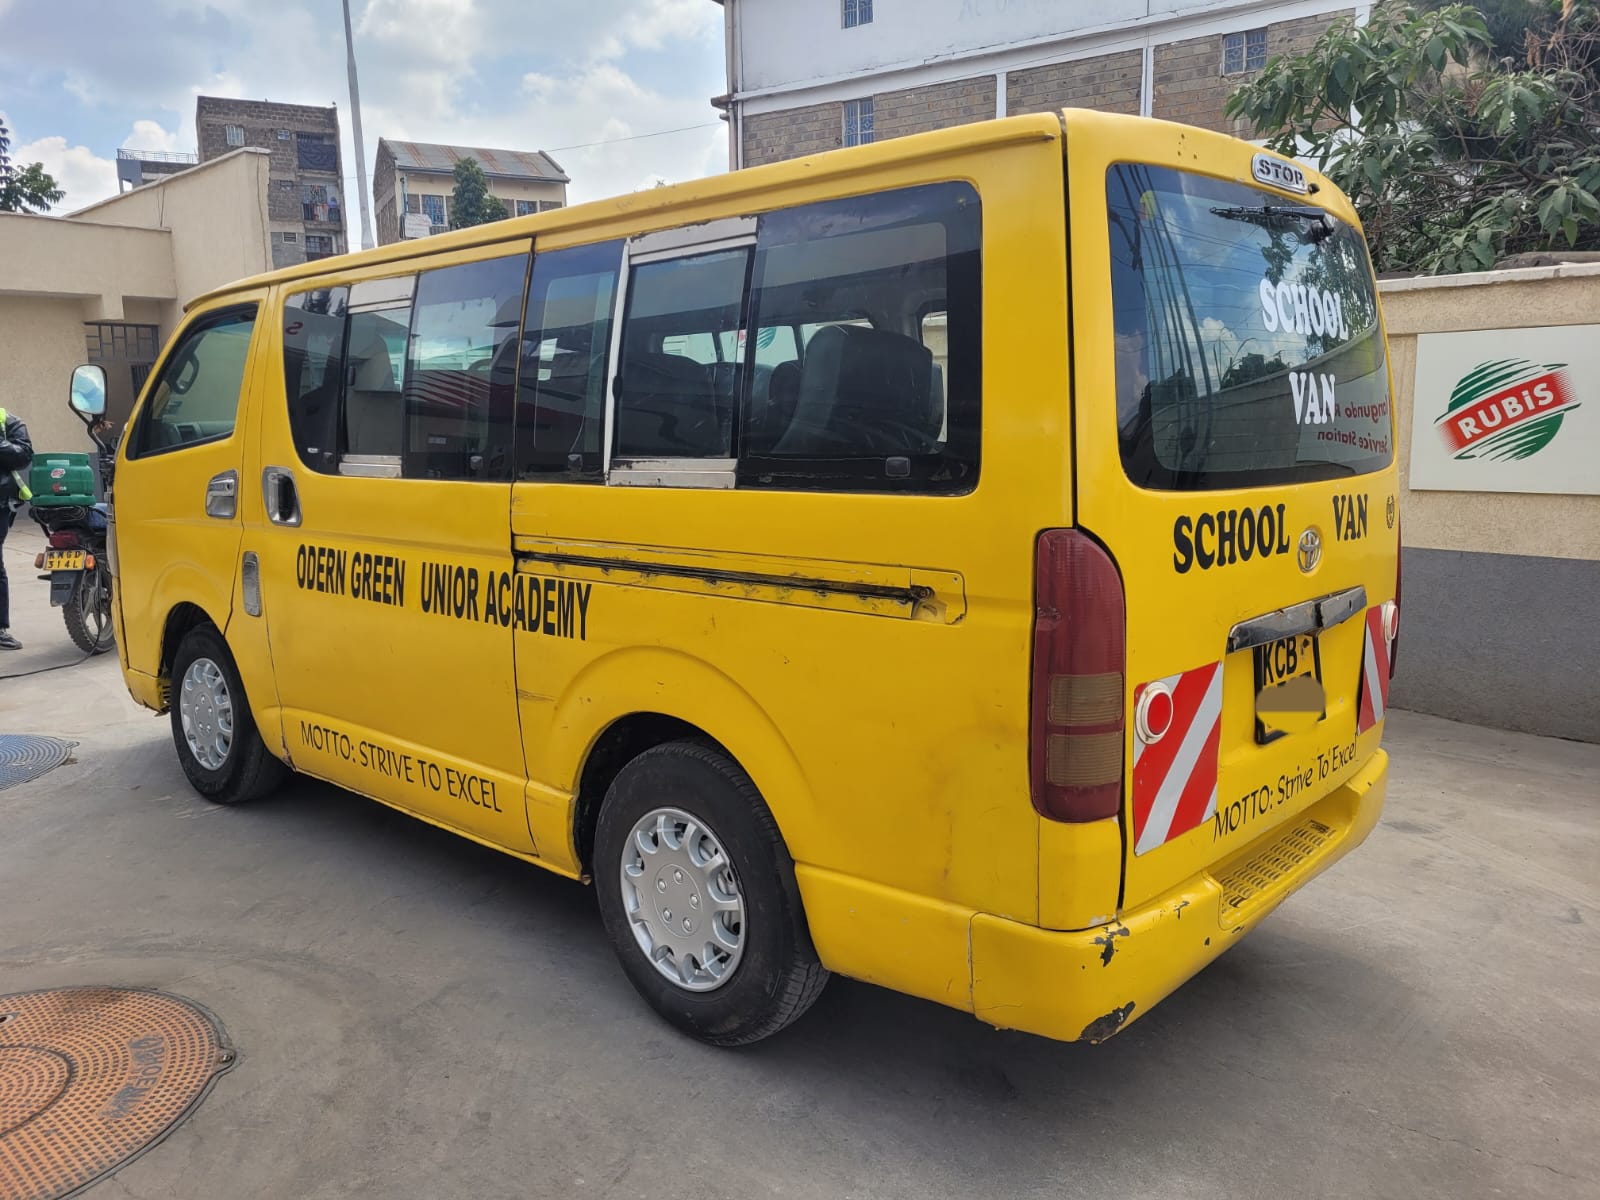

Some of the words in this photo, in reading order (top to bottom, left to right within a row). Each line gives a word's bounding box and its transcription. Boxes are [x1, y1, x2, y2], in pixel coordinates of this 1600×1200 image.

[1259, 159, 1303, 185] STOP
[1259, 278, 1349, 340] SCHOOL
[1288, 371, 1336, 425] VAN
[1173, 503, 1290, 574] SCHOOL
[1331, 493, 1369, 542] VAN
[296, 543, 347, 596] ODERN
[350, 551, 406, 608] GREEN
[420, 561, 479, 622] UNIOR
[484, 570, 593, 641] ACADEMY
[300, 721, 356, 764] MOTTO:
[359, 740, 414, 783] STRIVE
[417, 759, 441, 791] TO
[445, 767, 503, 813] EXCEL
[1213, 784, 1274, 843] MOTTO:
[1277, 765, 1313, 805] Strive
[1317, 752, 1330, 781] To
[1332, 732, 1358, 772] Excel
